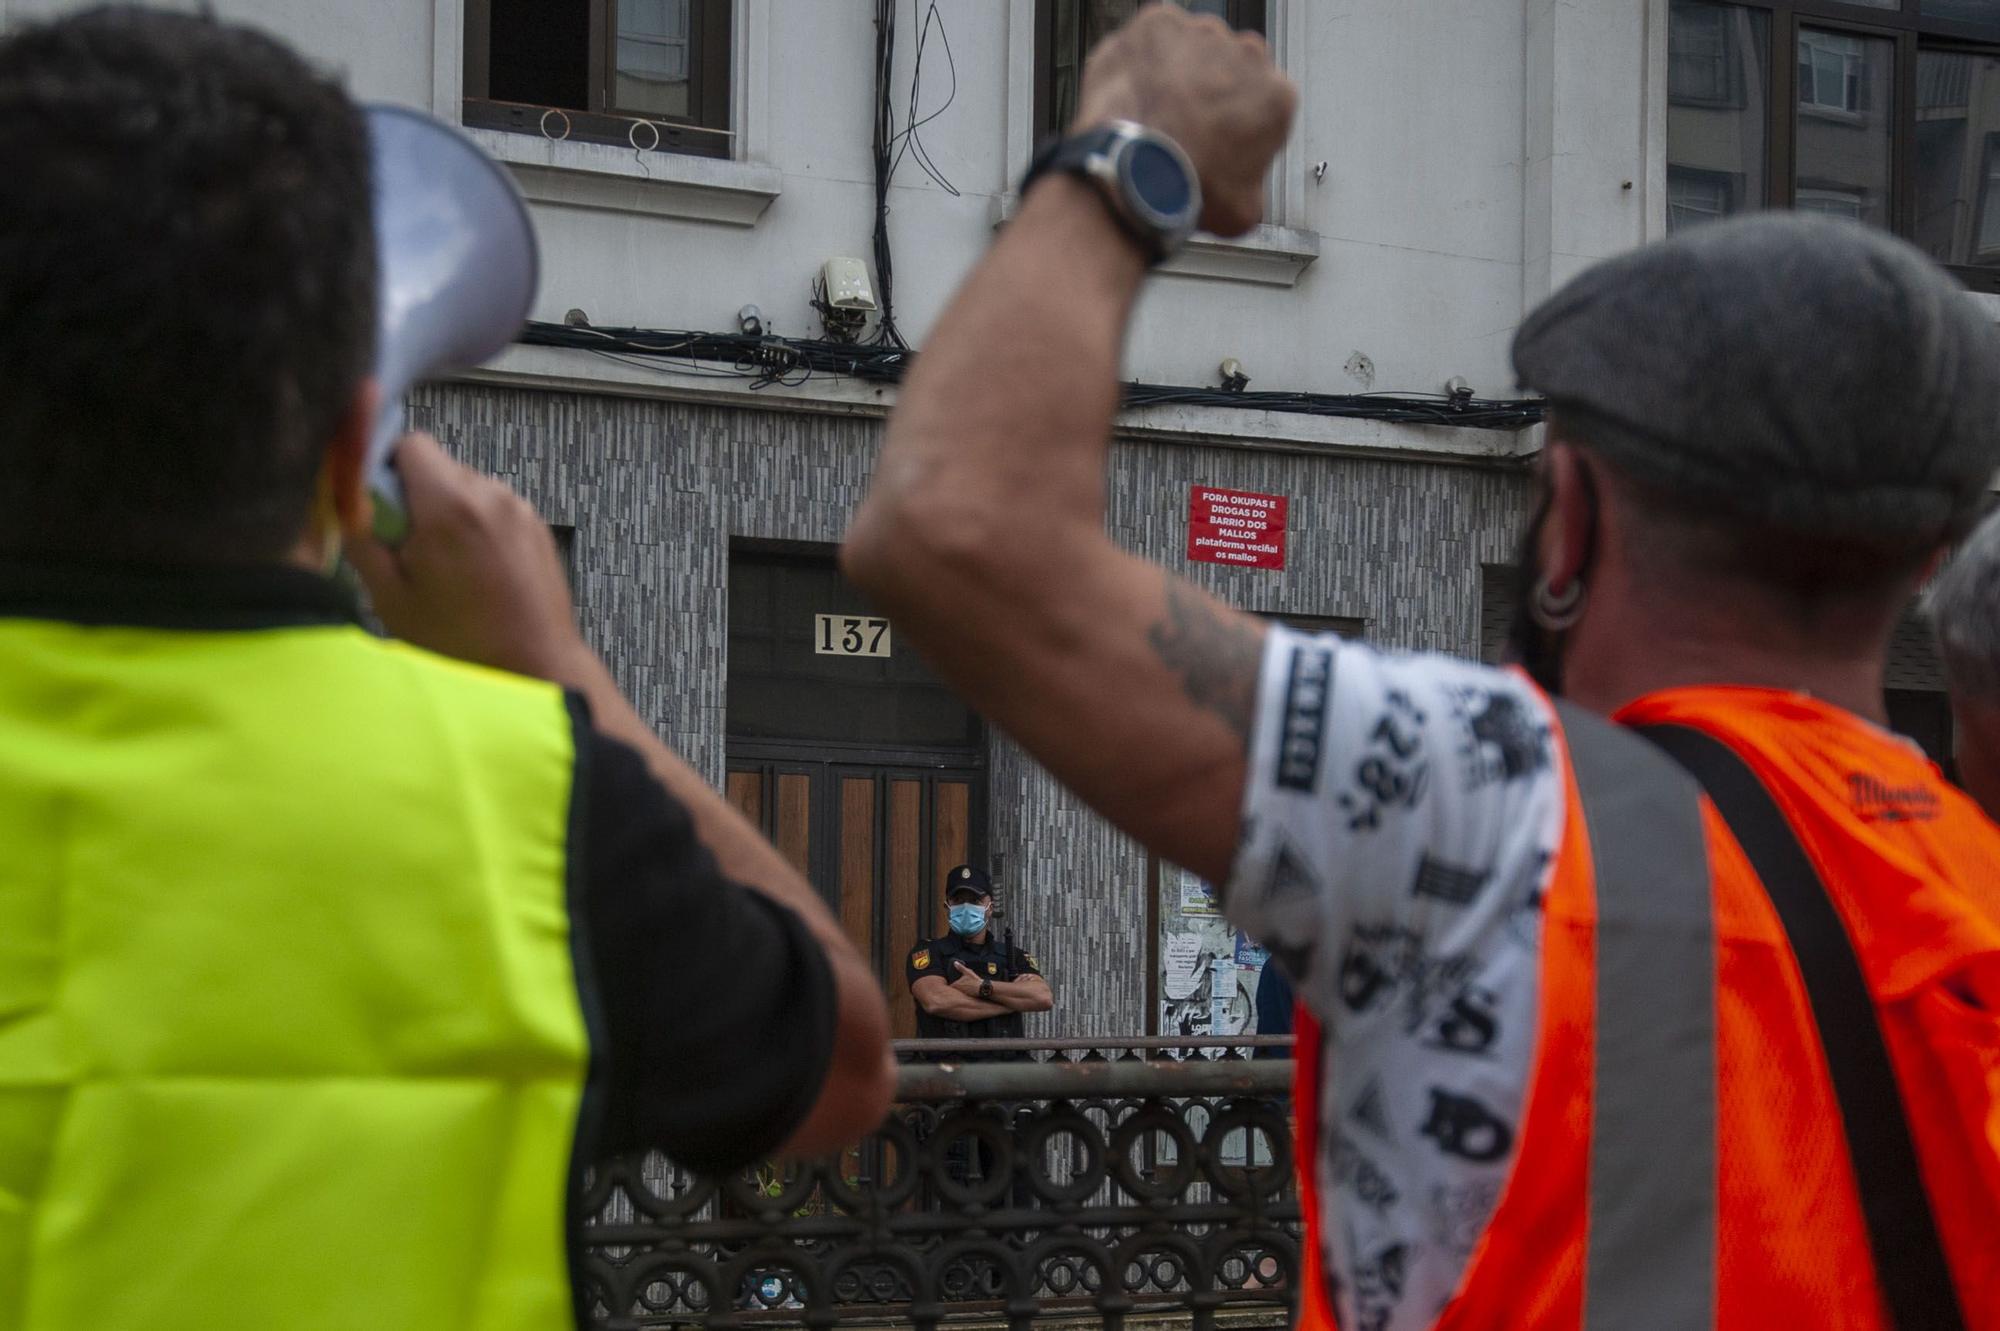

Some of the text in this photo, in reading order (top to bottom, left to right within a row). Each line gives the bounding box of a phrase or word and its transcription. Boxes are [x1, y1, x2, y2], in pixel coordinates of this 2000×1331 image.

[1202, 492, 1276, 509] FORA OKUPAS E
[1211, 504, 1267, 519] DROGAS DO
[1209, 516, 1267, 530] BARRIO DOS
[1218, 528, 1257, 540] MALLOS
[1195, 537, 1278, 554] plataforma veciñal
[1215, 551, 1257, 562] os mallos
[821, 617, 889, 654] 137
